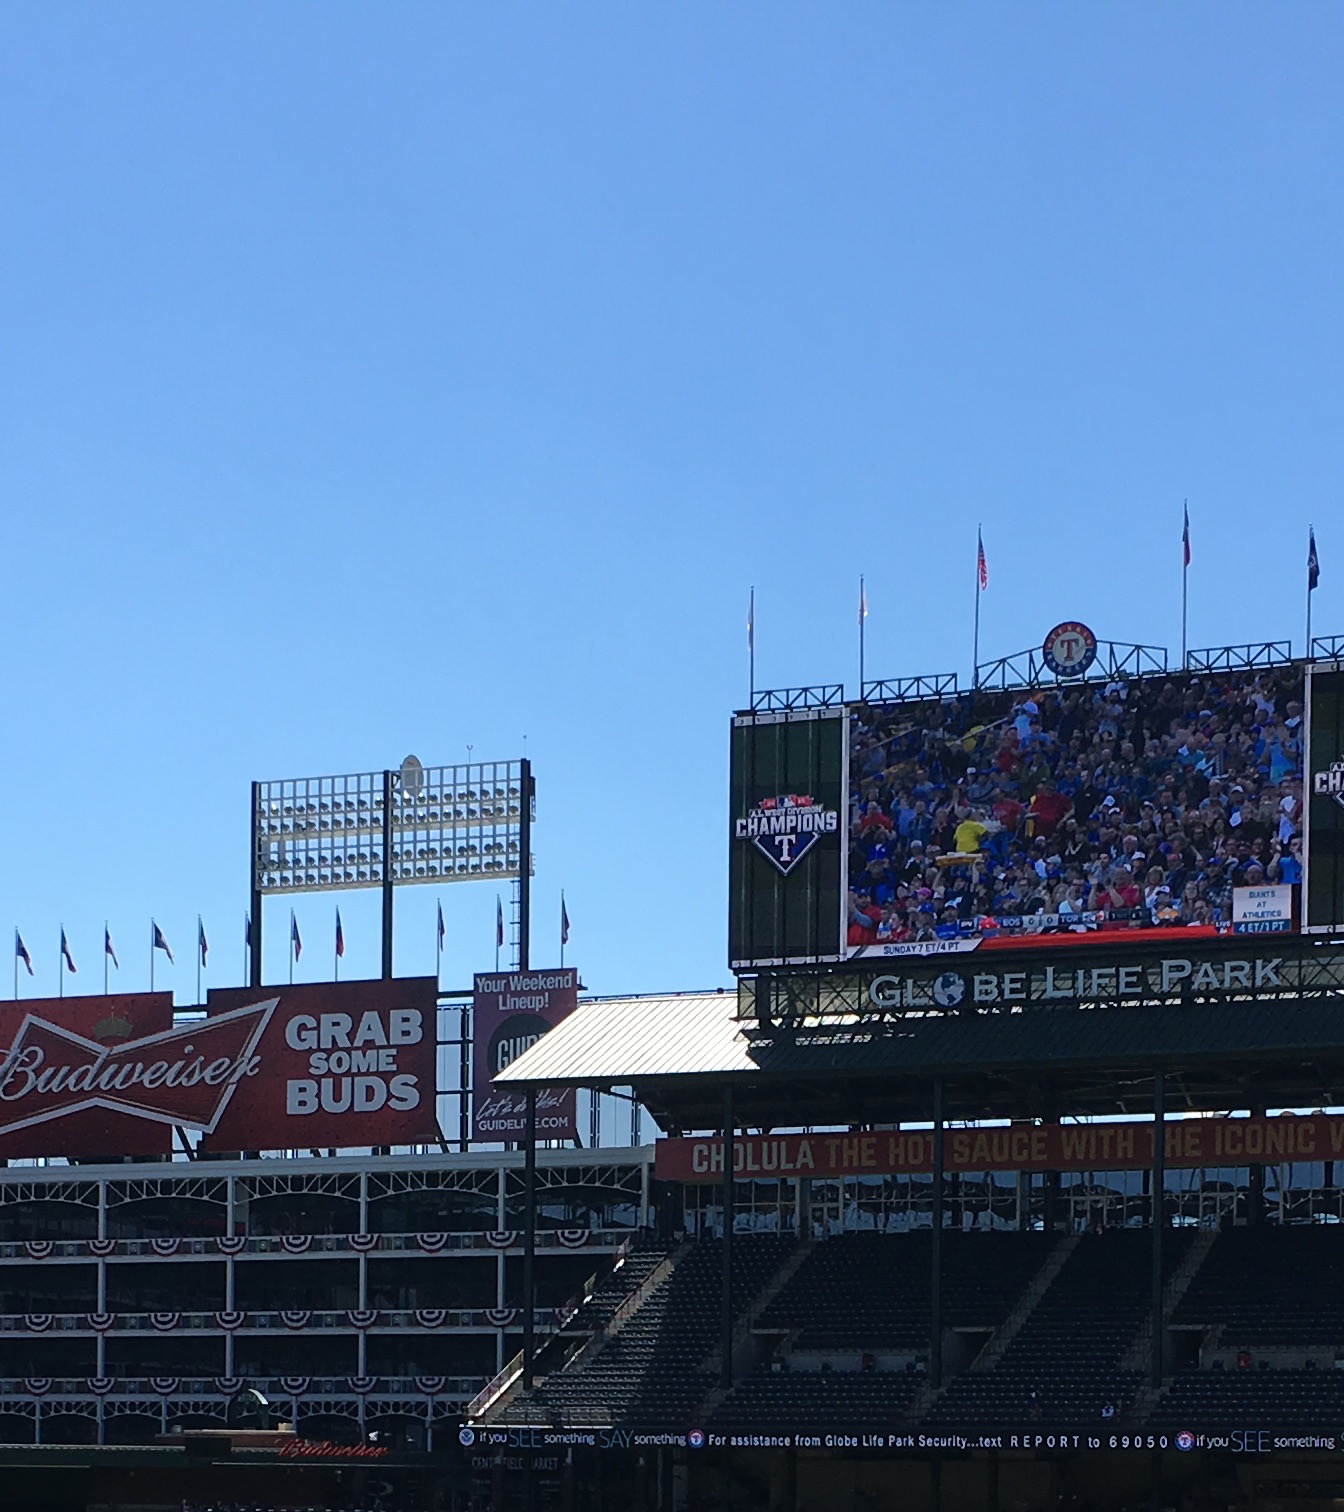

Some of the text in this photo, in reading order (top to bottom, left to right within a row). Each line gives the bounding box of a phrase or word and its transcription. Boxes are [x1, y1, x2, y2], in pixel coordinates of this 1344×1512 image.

[1060, 638, 1079, 661] T
[736, 811, 837, 837] CHAMPIONS
[775, 834, 795, 861] T
[1248, 890, 1276, 898] GIANTS
[1242, 909, 1282, 919] ATHLETICS
[1272, 921, 1285, 931] PT
[883, 943, 917, 955] SUNDAY
[948, 941, 960, 949] PT
[476, 972, 572, 994] Your Weekend
[1045, 960, 1144, 1000] LIFE
[1161, 955, 1282, 992] PARK
[498, 992, 549, 1013] Lineup!
[285, 1008, 424, 1051] GRAB
[308, 1048, 398, 1076] SOME
[286, 1074, 421, 1116] BUDS
[692, 1140, 817, 1174] CHOLULA
[825, 1138, 877, 1169] THE
[888, 1135, 936, 1167] HOT
[953, 1130, 1048, 1165] SAUCE
[1059, 1127, 1132, 1160] WITH
[1215, 1120, 1316, 1156] ICONIC
[479, 1429, 686, 1449] if you SEE something SAY something
[709, 1434, 727, 1446] For
[729, 1434, 791, 1447] assistance
[794, 1434, 822, 1447] from
[824, 1434, 858, 1447] Globe
[862, 1434, 884, 1447] Life
[888, 1434, 916, 1447] Park
[1087, 1436, 1100, 1449] to
[1196, 1433, 1205, 1447] if
[1205, 1435, 1229, 1449] you
[1230, 1430, 1271, 1452] SEE
[1273, 1434, 1336, 1450] something
